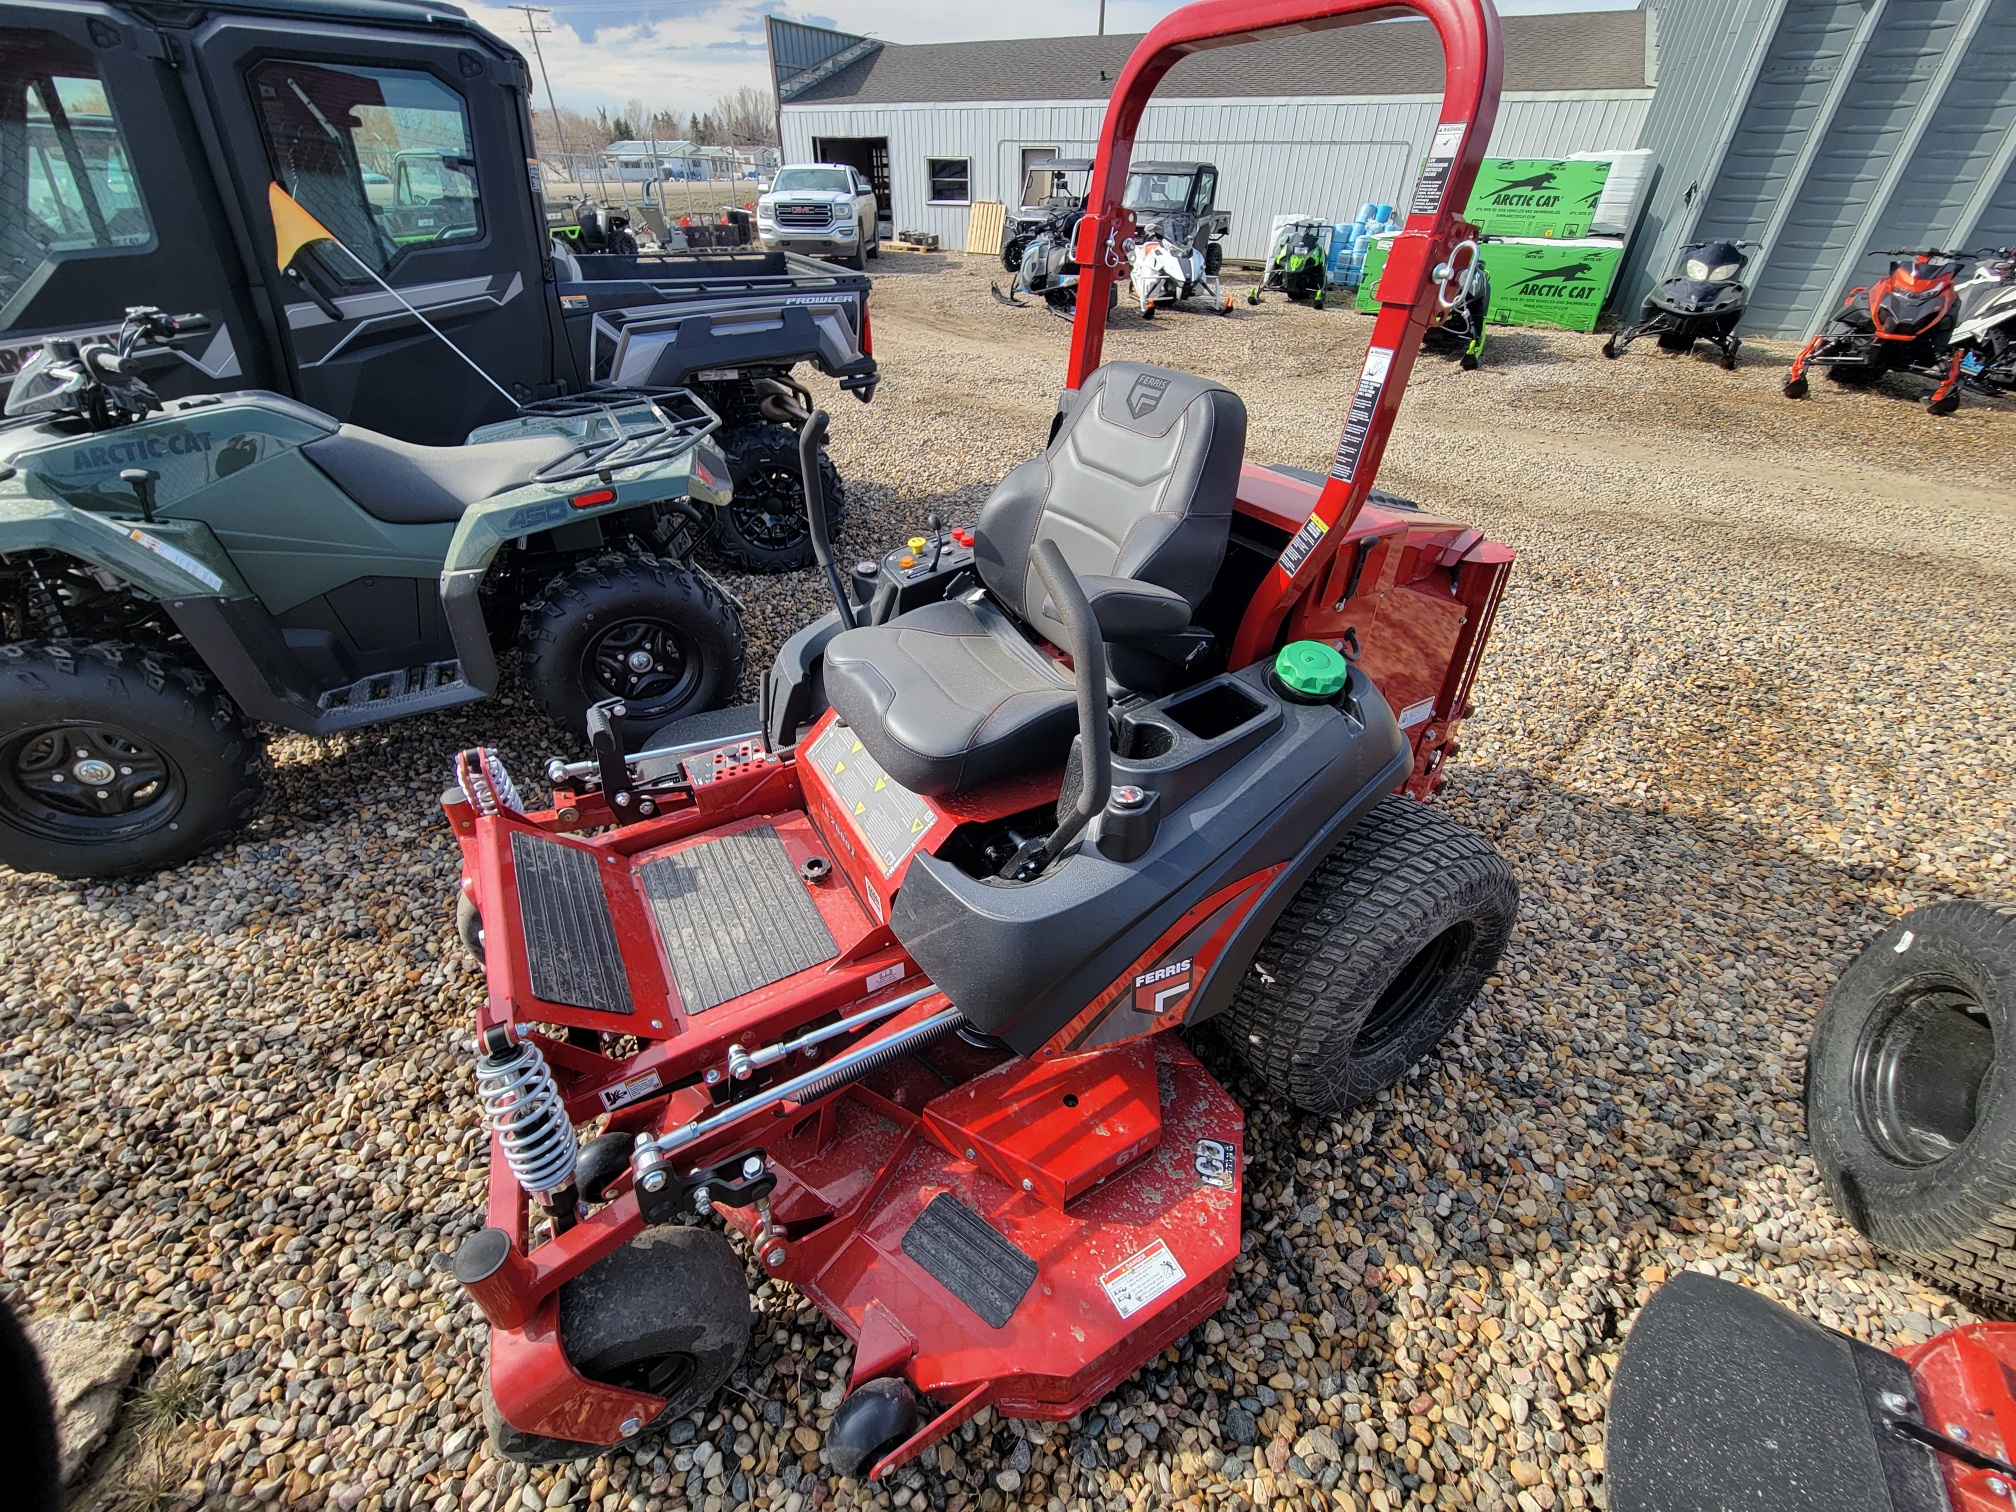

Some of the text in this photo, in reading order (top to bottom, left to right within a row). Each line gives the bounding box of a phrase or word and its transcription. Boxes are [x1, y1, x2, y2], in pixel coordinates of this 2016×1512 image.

[1492, 194, 1560, 207] ARCTIC CAT
[786, 296, 853, 304] PROWLER
[1519, 284, 1596, 299] ARCTIC CAT
[1139, 376, 1167, 389] FERRIS
[74, 431, 211, 470] ARCTIC CAT
[508, 500, 568, 528] 450
[1136, 958, 1191, 988] FERRIS
[1116, 1138, 1148, 1166] 61"
[1124, 1252, 1146, 1269] DANGER
